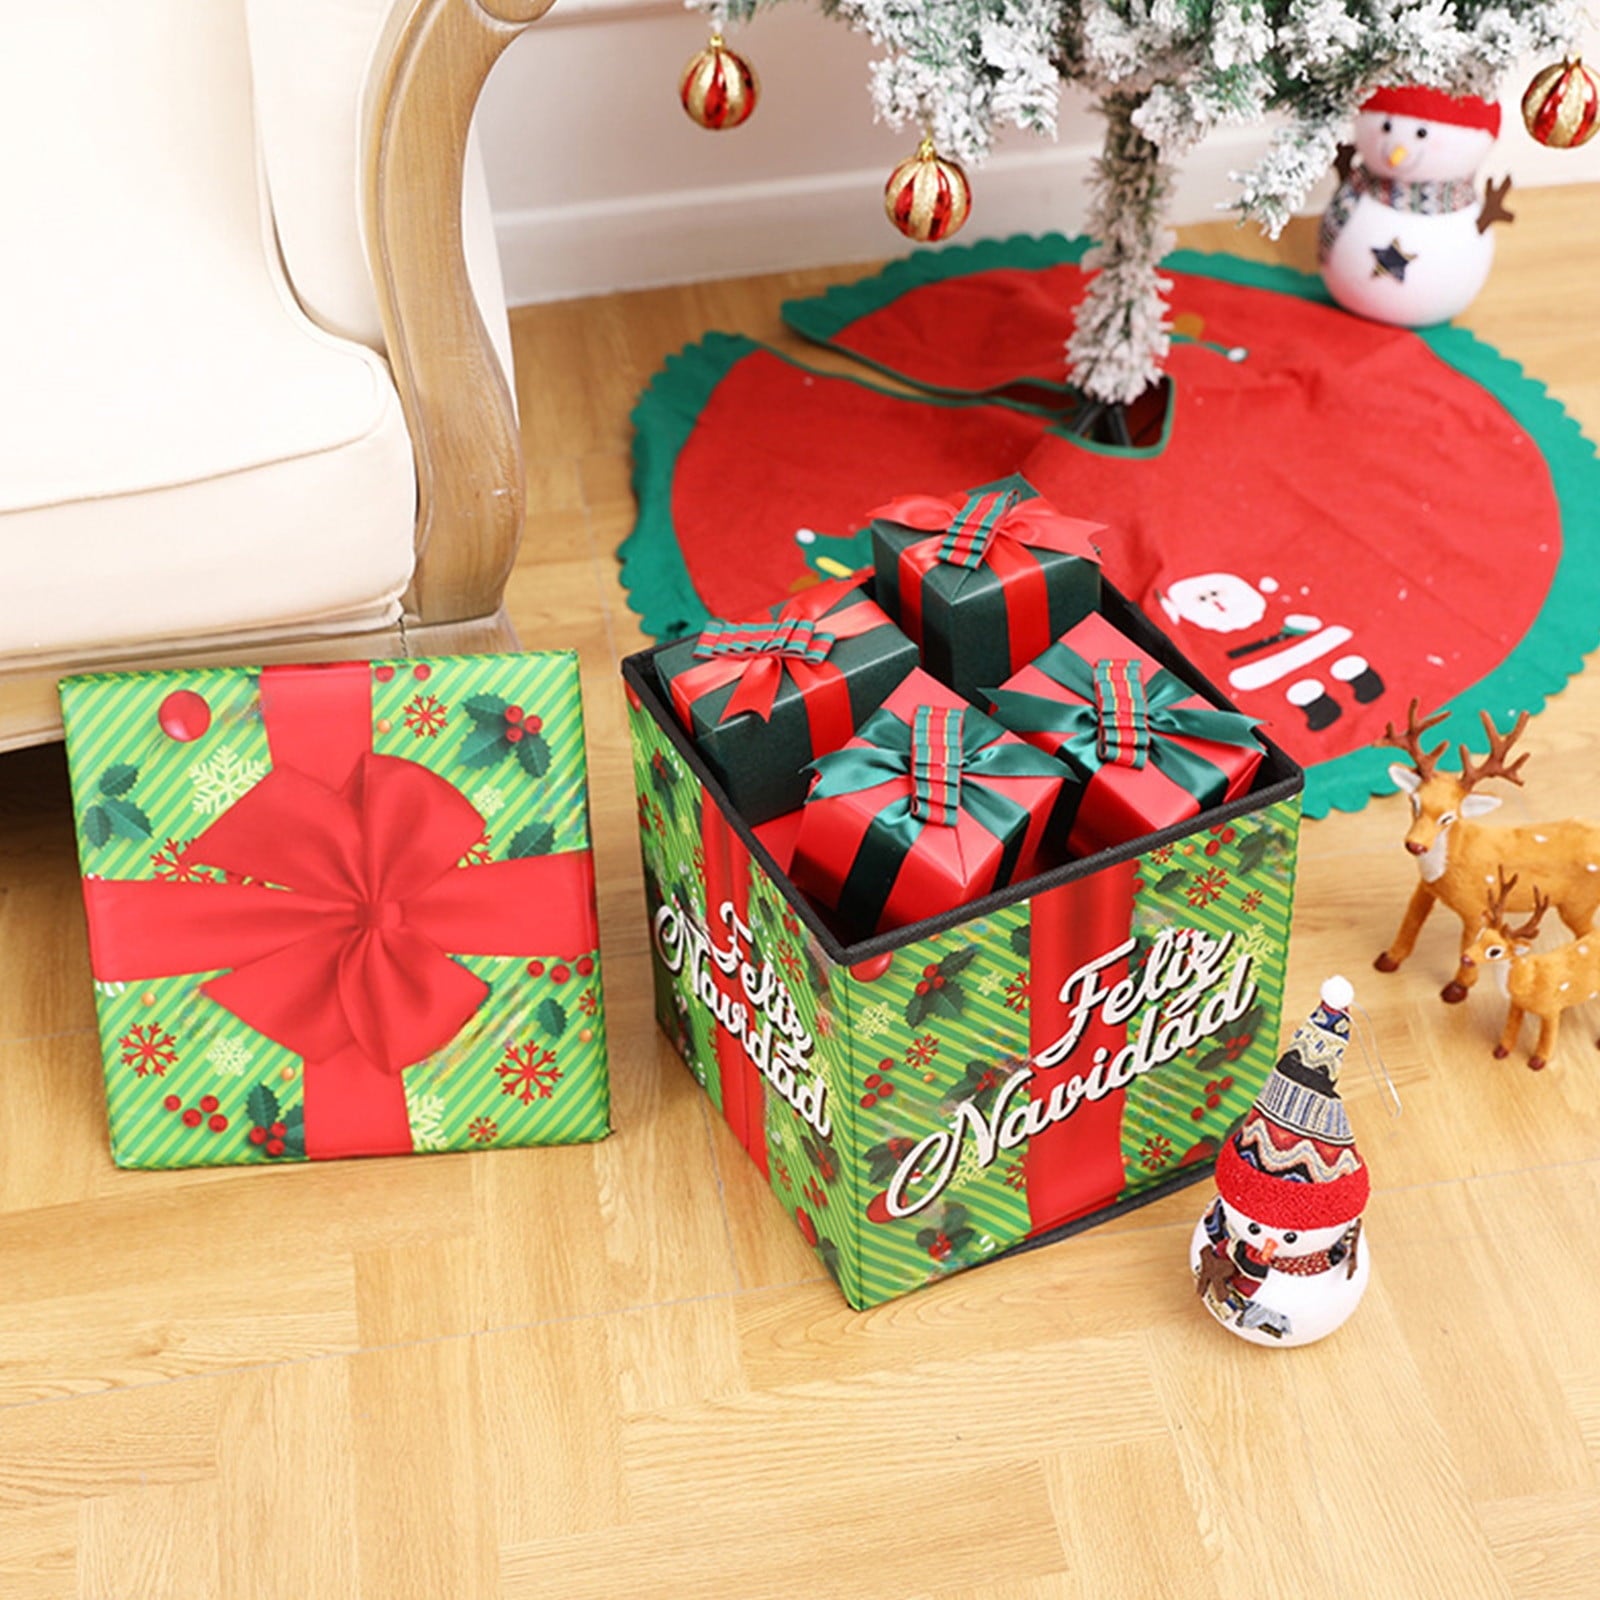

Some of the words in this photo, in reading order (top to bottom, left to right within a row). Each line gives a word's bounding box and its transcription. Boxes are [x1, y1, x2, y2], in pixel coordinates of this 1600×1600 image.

[655, 904, 832, 1138] Navidad
[887, 955, 1258, 1218] Navidad
[1035, 927, 1234, 1068] Feliz
